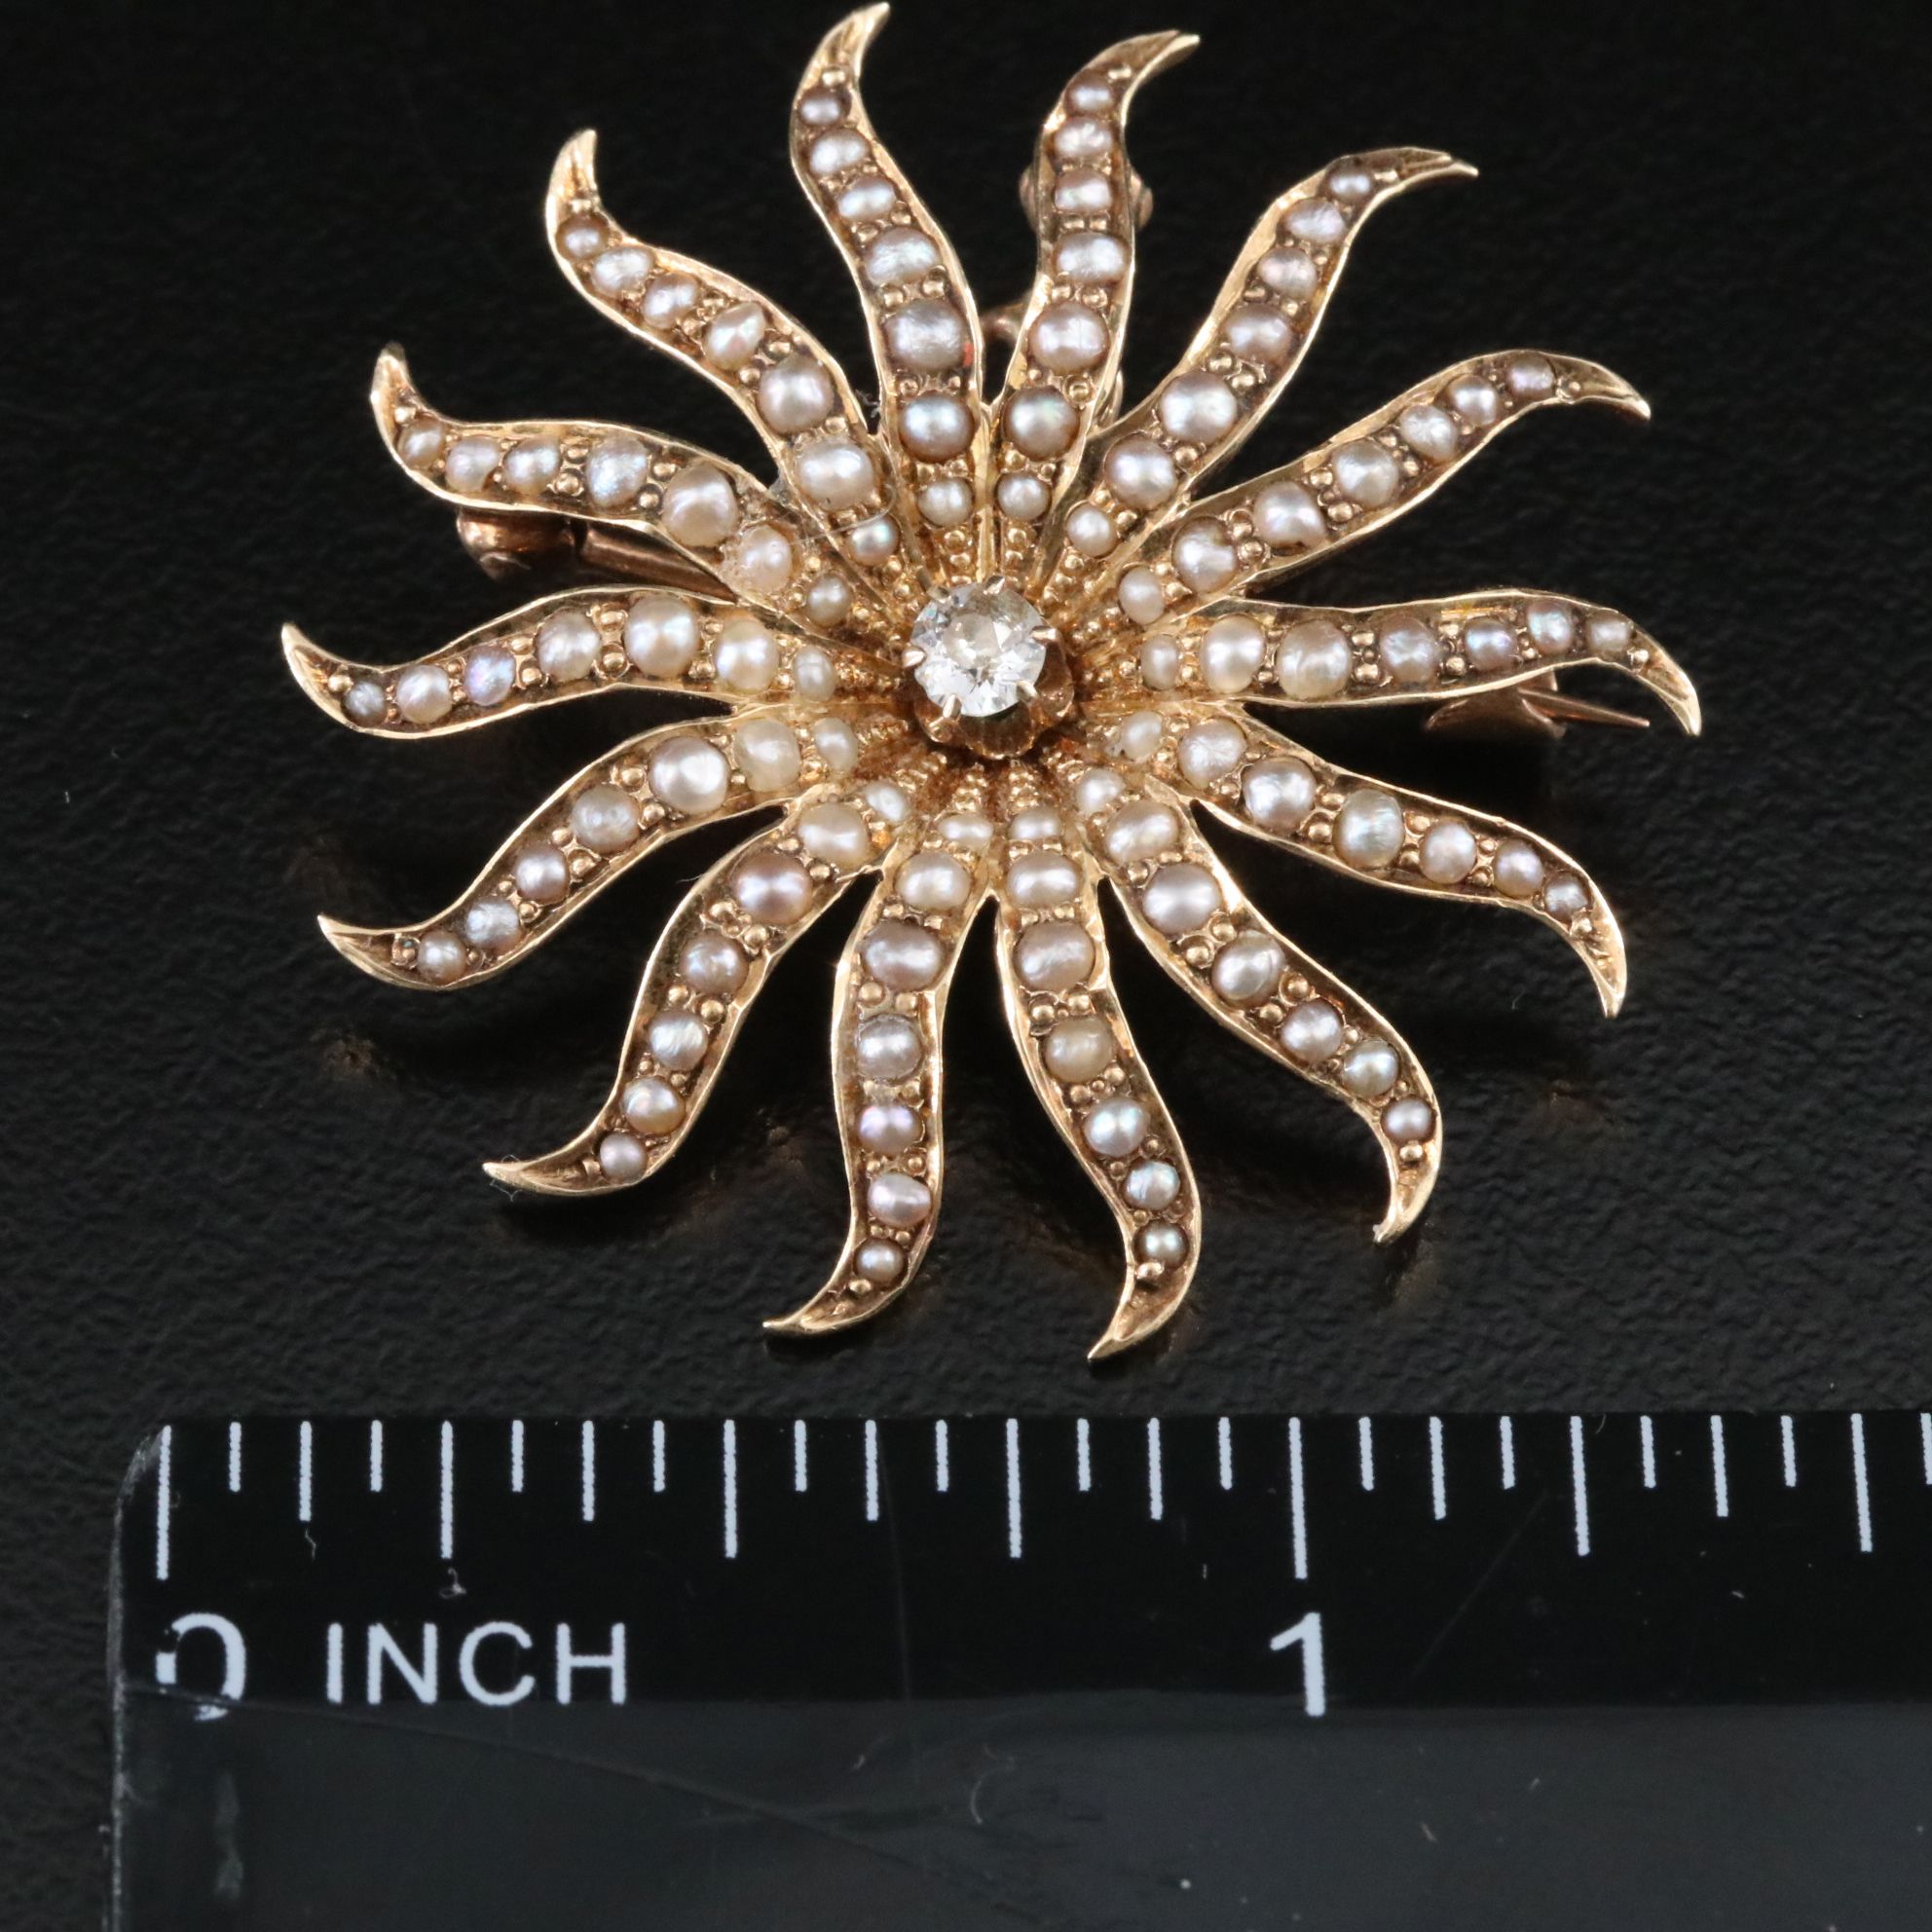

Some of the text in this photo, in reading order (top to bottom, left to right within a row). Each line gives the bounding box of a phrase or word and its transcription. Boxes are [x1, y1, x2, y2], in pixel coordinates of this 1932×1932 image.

[155, 1612, 1325, 1721] 0 INCH 1
